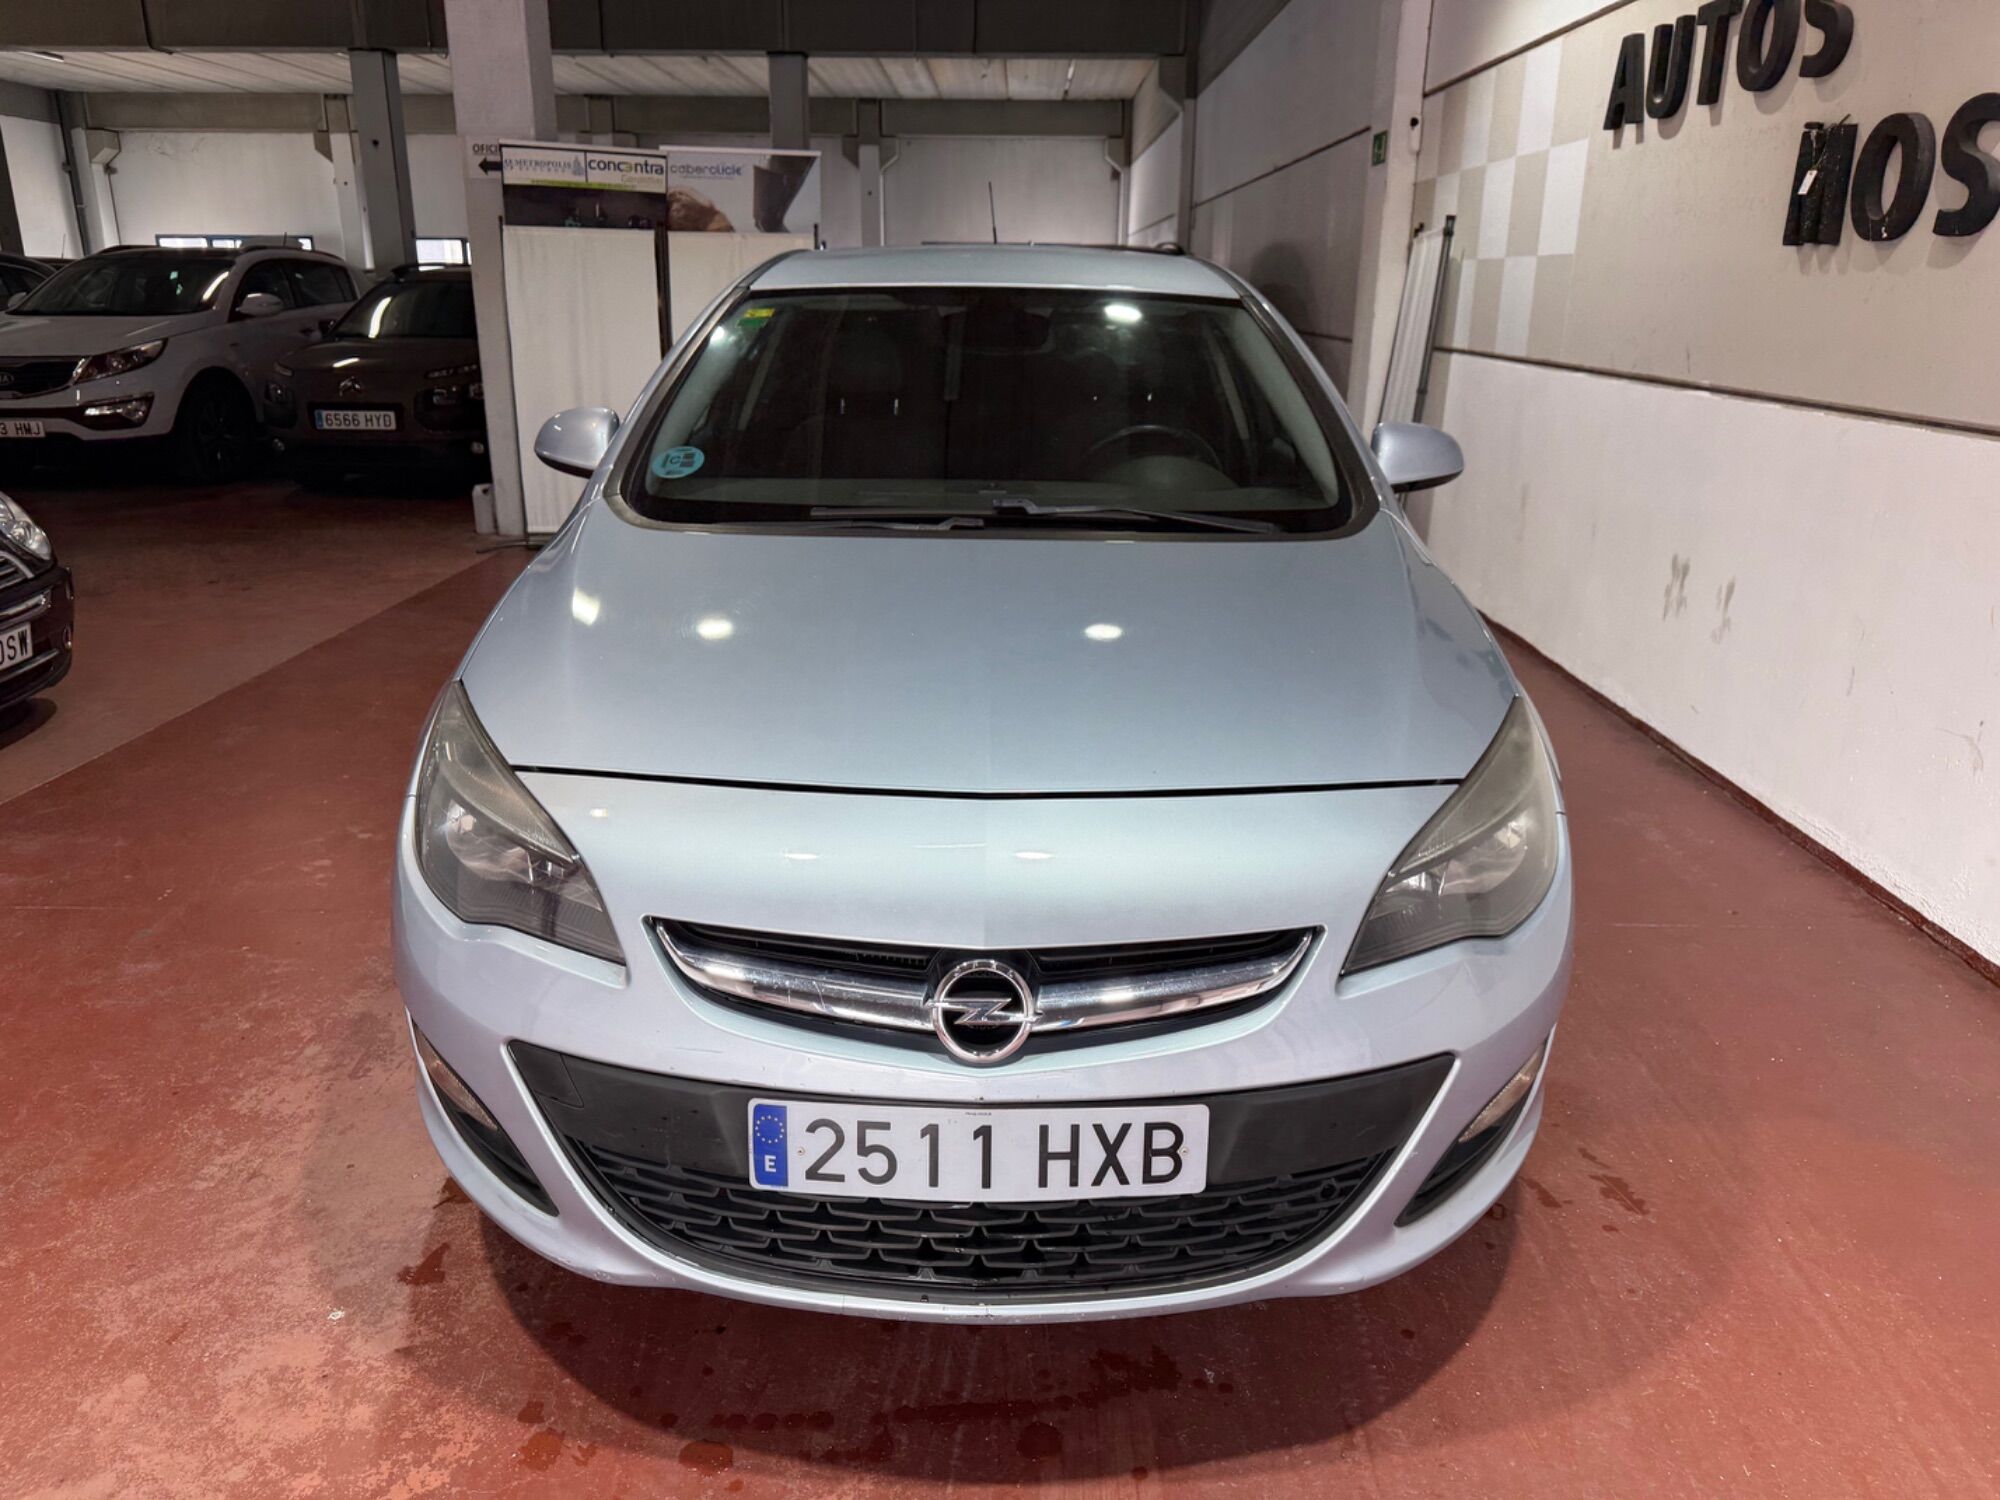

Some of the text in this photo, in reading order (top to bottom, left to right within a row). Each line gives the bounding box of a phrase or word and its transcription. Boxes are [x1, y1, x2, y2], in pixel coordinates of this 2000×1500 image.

[1603, 0, 1854, 130] AUTOS
[325, 412, 392, 428] 6566 HYD
[764, 1153, 777, 1173] E
[804, 1118, 1185, 1189] 2511 HXB
